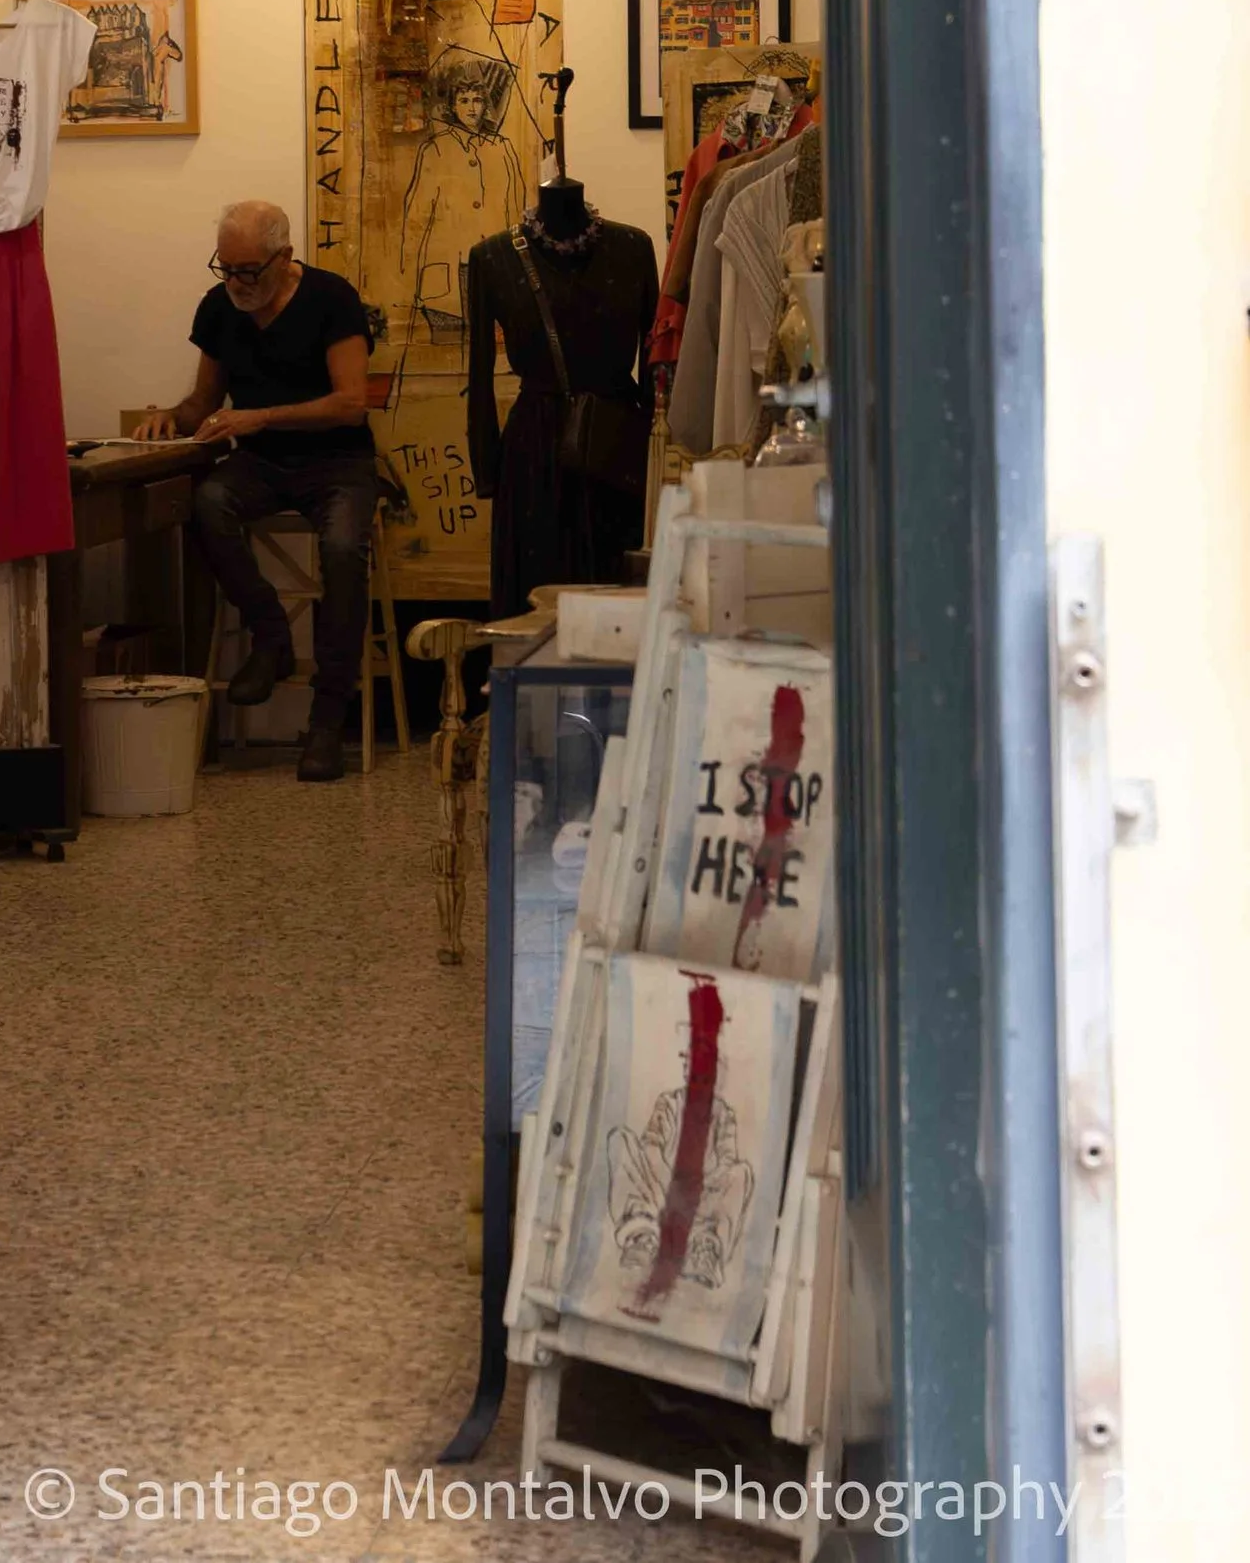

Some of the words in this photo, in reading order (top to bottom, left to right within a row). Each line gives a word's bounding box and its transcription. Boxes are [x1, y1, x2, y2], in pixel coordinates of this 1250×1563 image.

[392, 444, 464, 474] THIS
[421, 475, 475, 499] SID
[439, 504, 477, 534] UP
[697, 760, 724, 815] I
[734, 763, 823, 827] STOP
